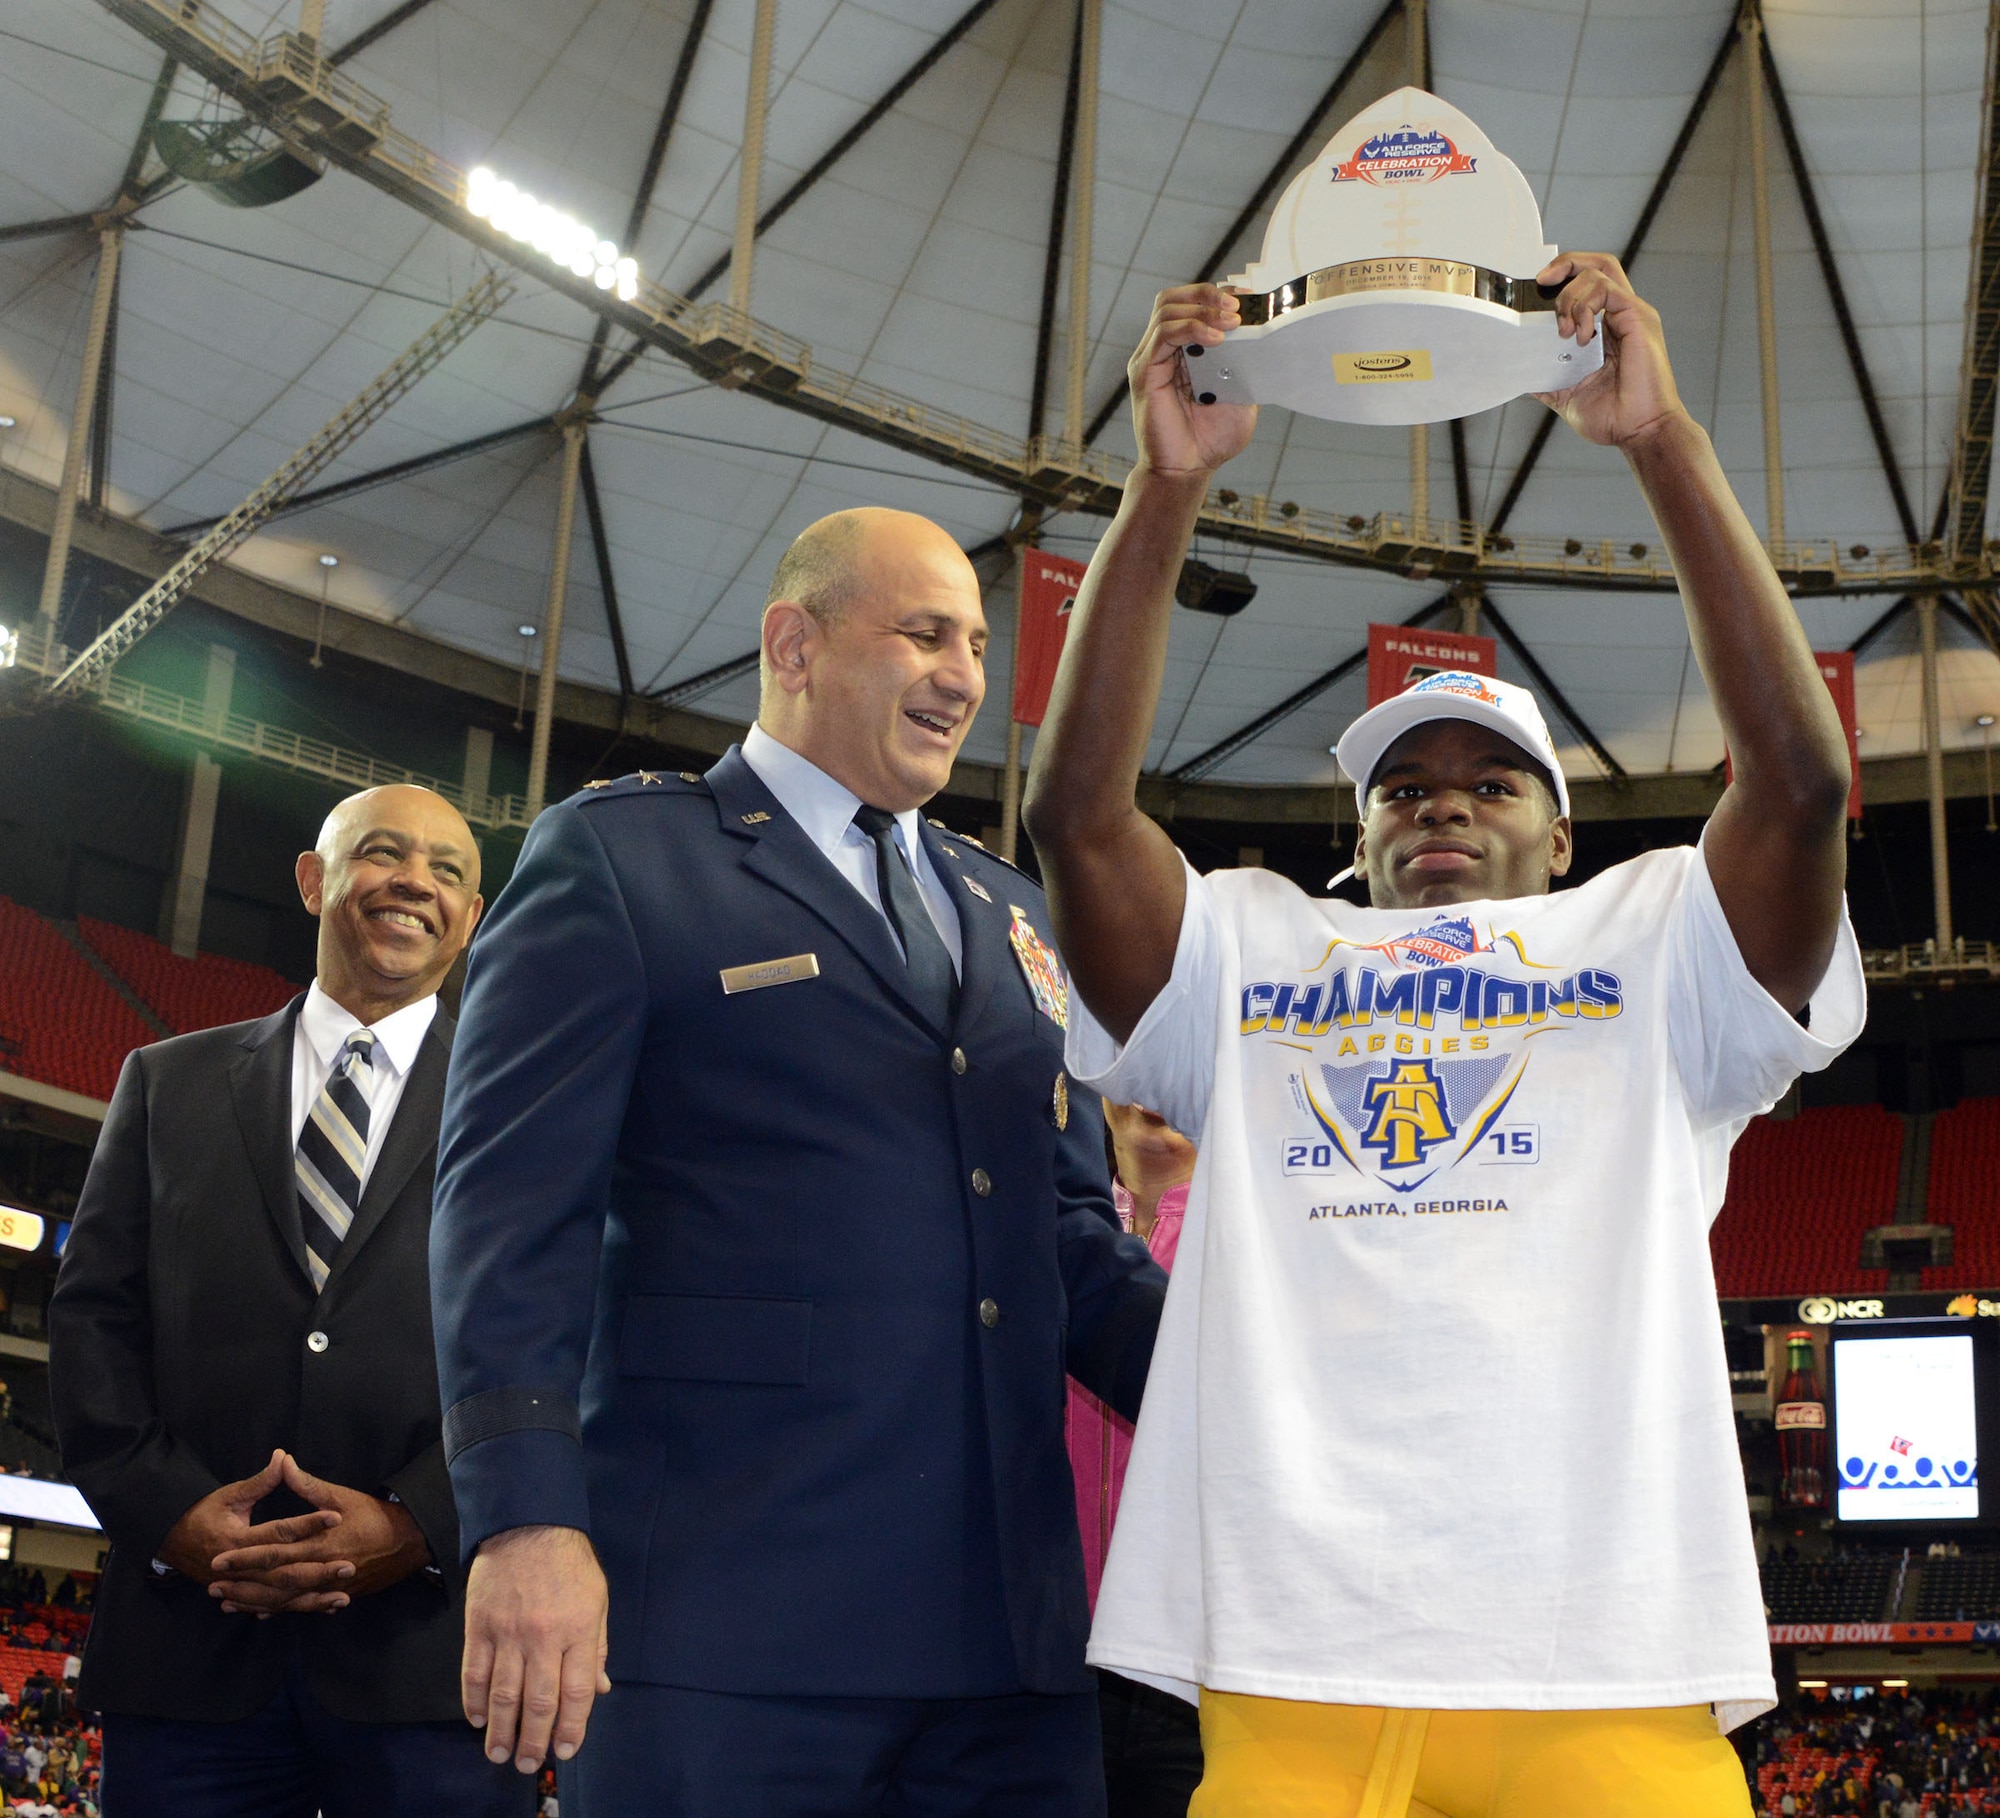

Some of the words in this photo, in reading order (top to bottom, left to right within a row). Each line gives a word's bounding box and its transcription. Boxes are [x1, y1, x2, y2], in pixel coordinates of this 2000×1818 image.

[1382, 144, 1399, 152] AIR
[1404, 142, 1445, 150] FORCE
[1385, 148, 1440, 157] RESERVE
[1356, 156, 1452, 171] CELEBRATION
[1384, 169, 1425, 179] BOWL
[1314, 263, 1419, 285] OFFENSIVE
[1430, 264, 1467, 277] MVP
[1346, 275, 1394, 286] DECEMBER
[1357, 357, 1401, 368] jostens
[1385, 640, 1480, 663] FALCONS
[1240, 966, 1624, 1036] CHAMPIONS
[1337, 1034, 1490, 1057] AGGIES
[1488, 1132, 1533, 1155] 15
[1287, 1145, 1331, 1167] 20
[1309, 1202, 1407, 1220] ATLANTA,
[1414, 1199, 1509, 1215] GEORGIA
[1838, 1299, 1885, 1318] NCR
[1831, 1624, 1894, 1642] BOWL
